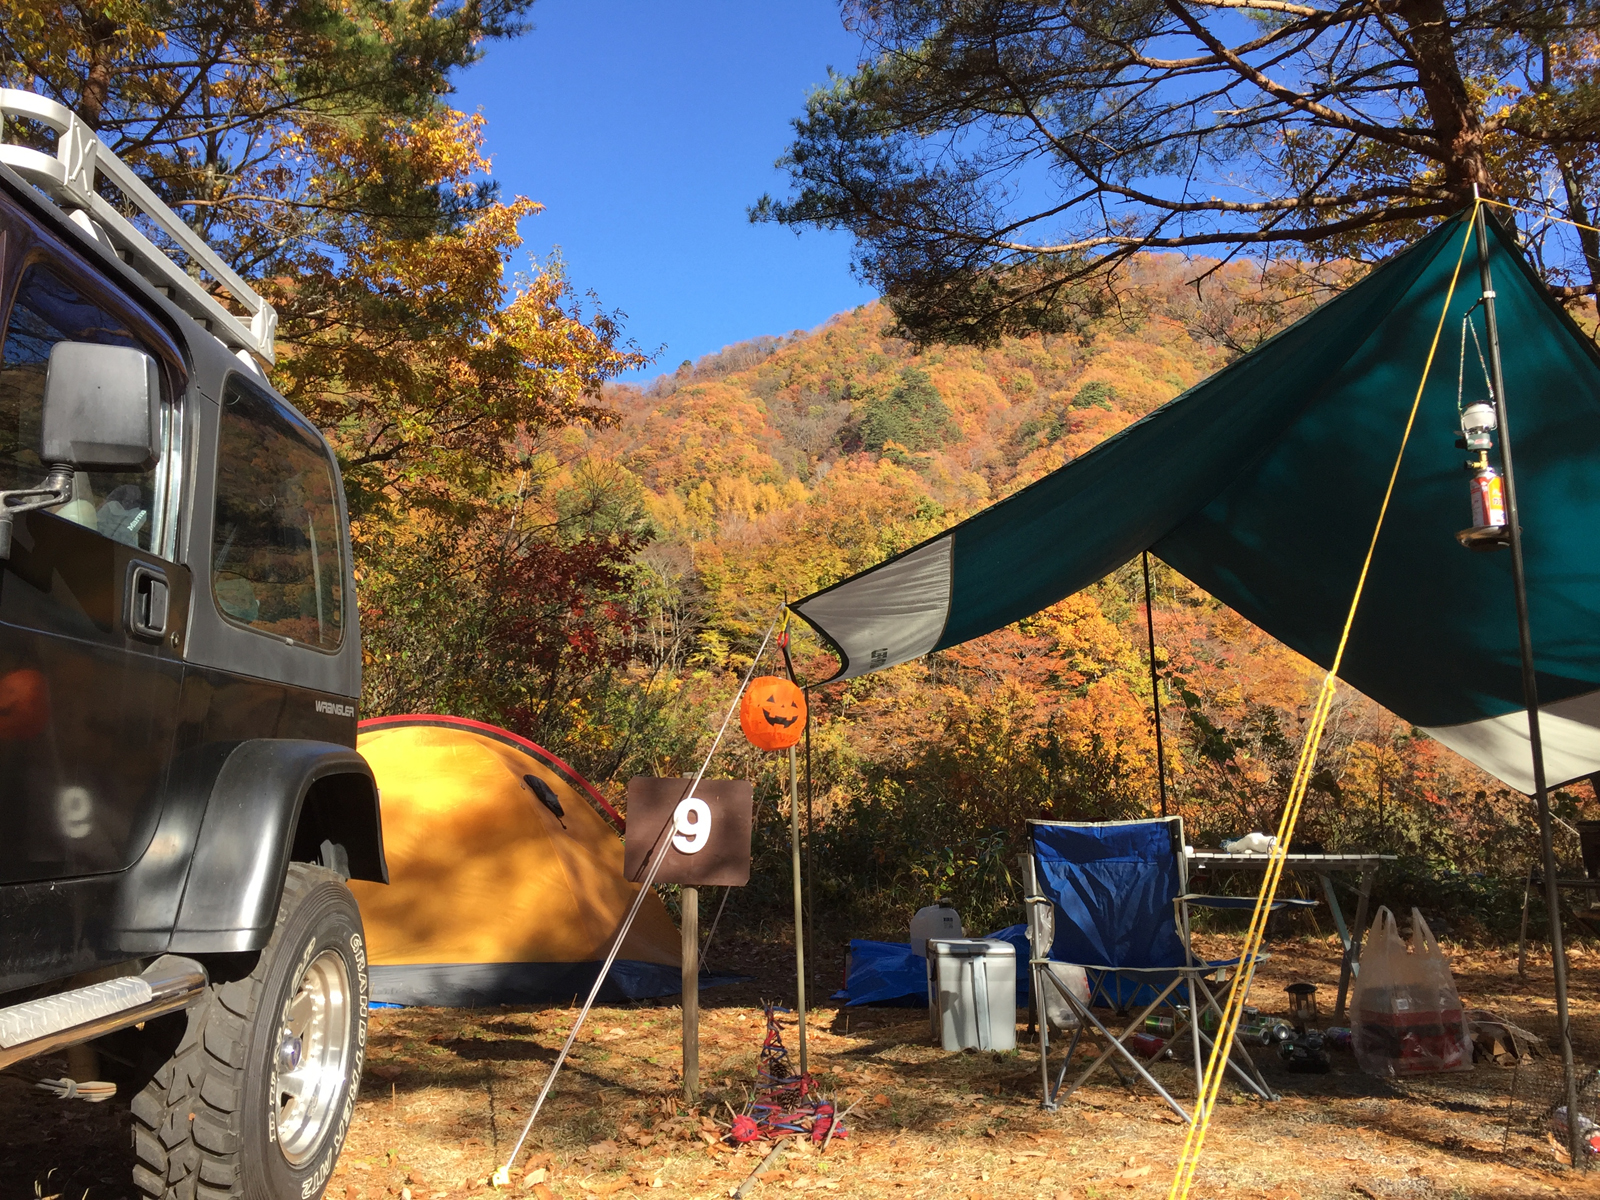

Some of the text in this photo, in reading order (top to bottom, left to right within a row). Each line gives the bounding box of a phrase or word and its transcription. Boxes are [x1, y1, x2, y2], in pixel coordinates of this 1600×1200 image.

[315, 700, 354, 717] WRANGLER
[671, 797, 712, 854] 9
[302, 1147, 333, 1199] MT2
